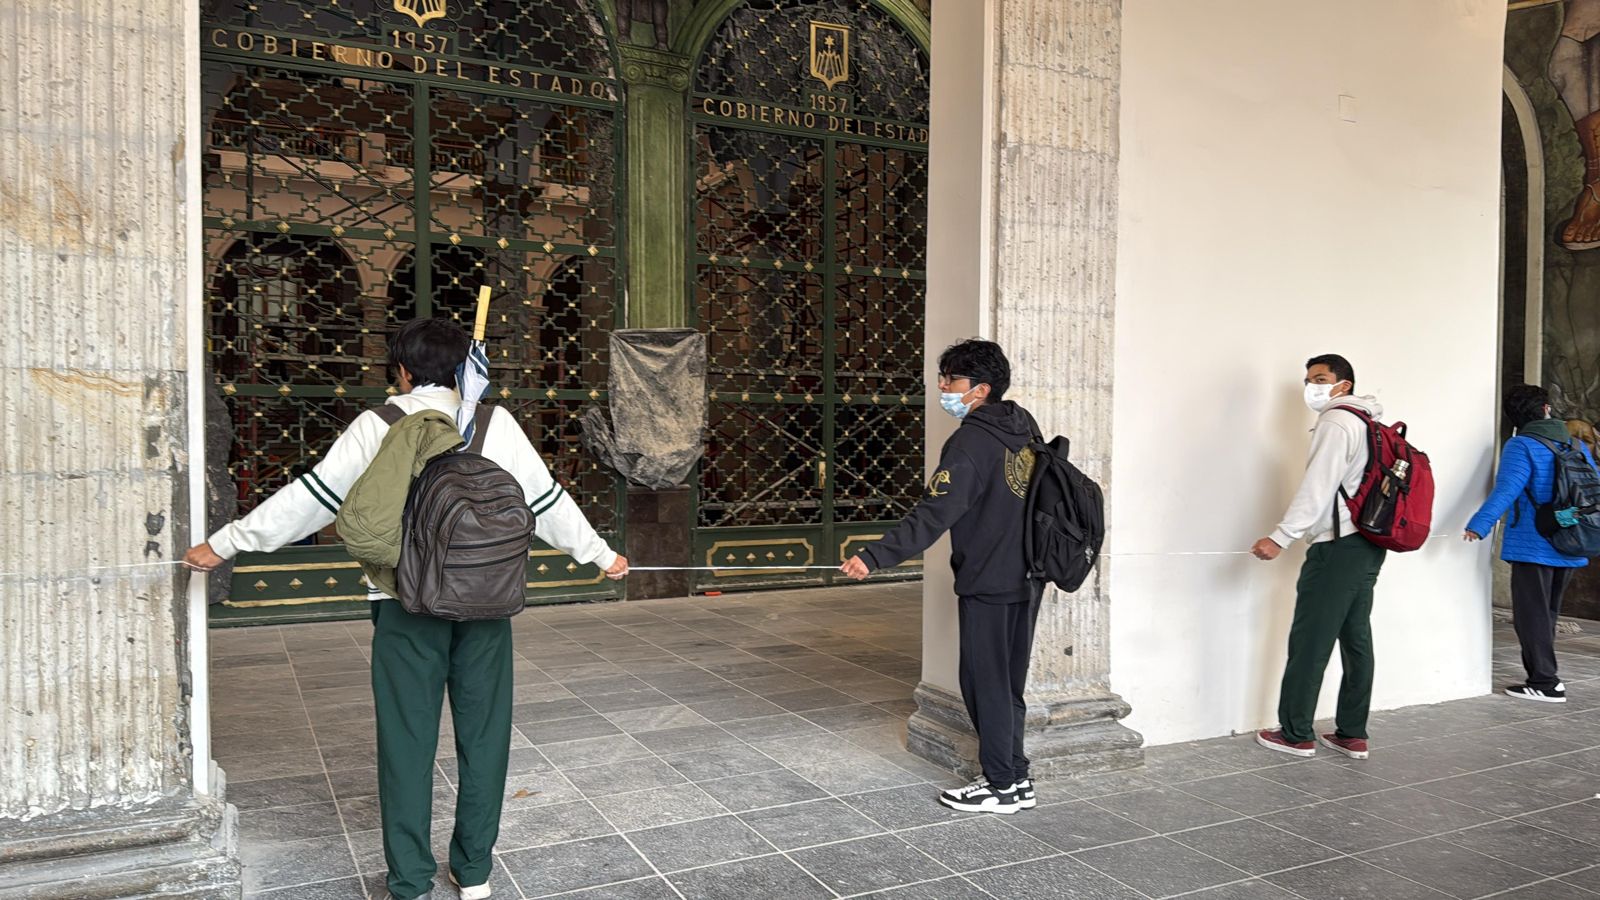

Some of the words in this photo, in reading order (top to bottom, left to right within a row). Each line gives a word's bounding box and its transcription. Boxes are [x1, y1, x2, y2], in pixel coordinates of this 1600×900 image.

[392, 30, 448, 55] 1957
[413, 55, 470, 80] DEL
[488, 65, 605, 99] ESTADO
[810, 93, 847, 114] 1957
[828, 115, 867, 136] DEL
[874, 121, 928, 143] ESTAD
